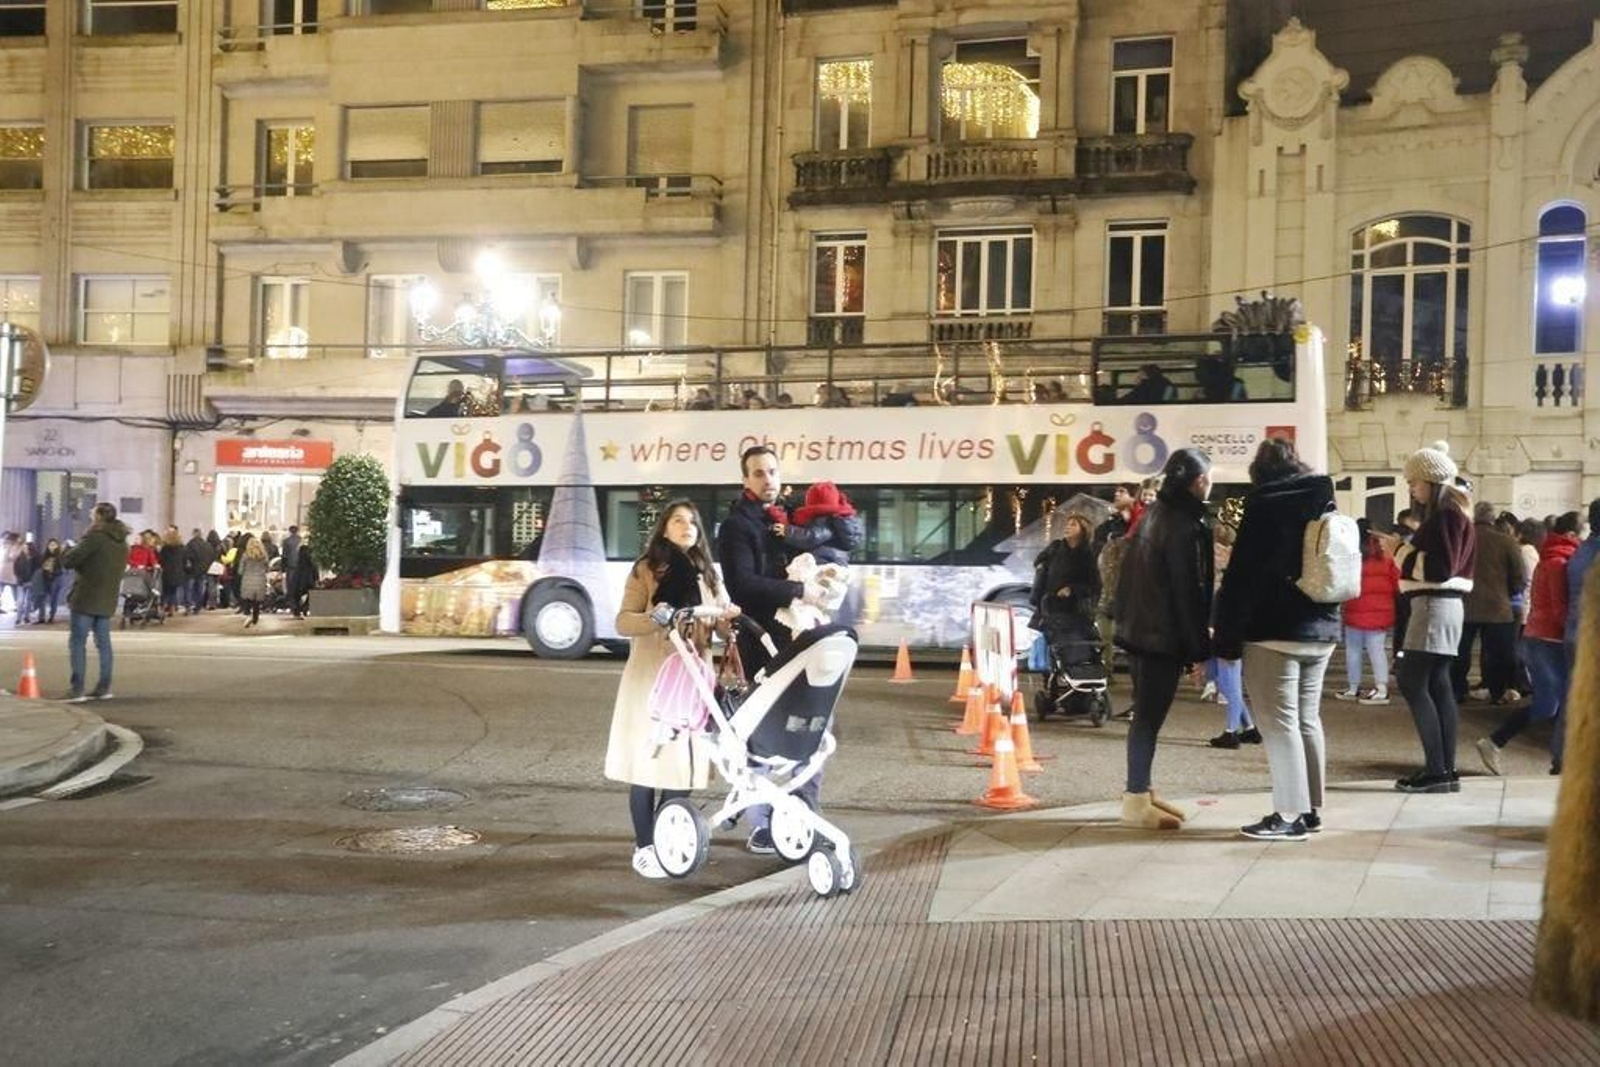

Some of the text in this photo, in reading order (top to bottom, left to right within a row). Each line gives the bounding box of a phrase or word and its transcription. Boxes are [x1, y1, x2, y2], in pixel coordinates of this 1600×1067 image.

[1190, 433, 1256, 444] CONCELLO
[629, 432, 994, 462] where Christmas lives
[1218, 445, 1249, 455] VIGO
